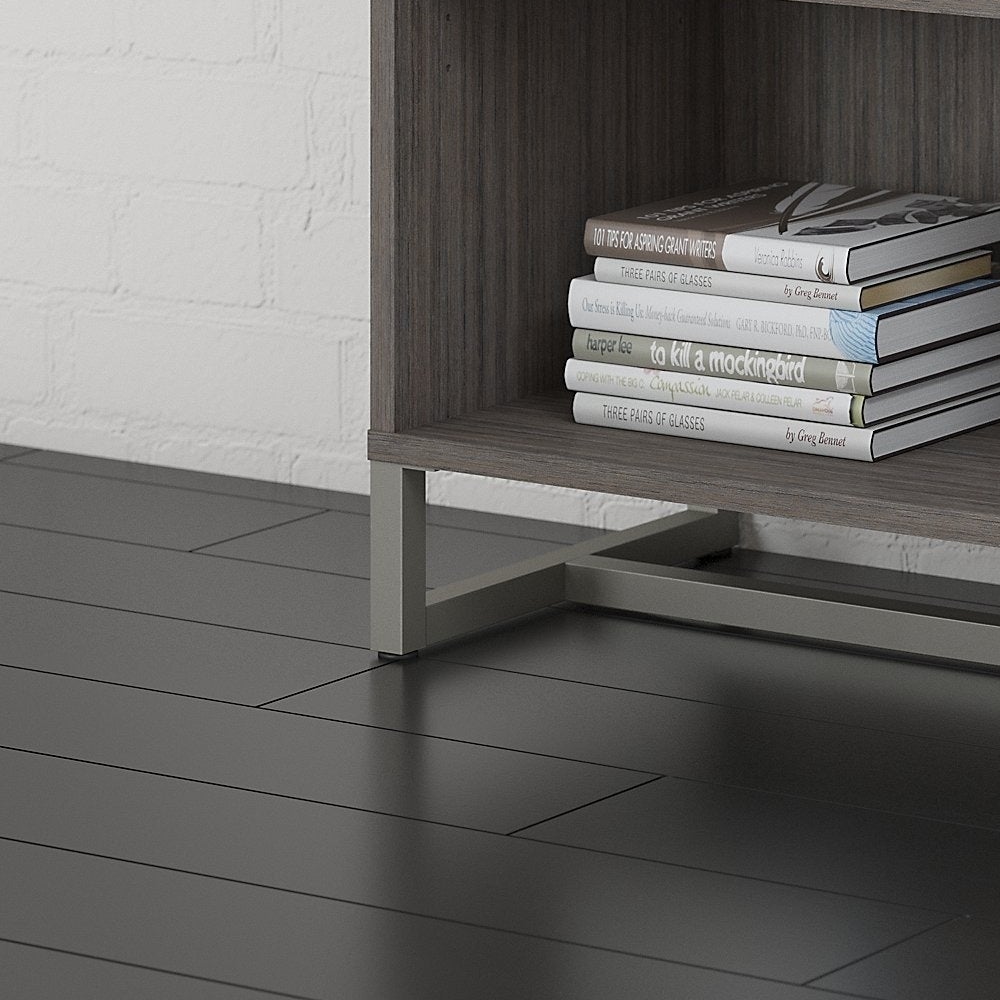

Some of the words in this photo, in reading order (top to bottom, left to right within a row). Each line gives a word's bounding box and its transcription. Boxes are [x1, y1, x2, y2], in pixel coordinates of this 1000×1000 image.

[594, 228, 605, 246] 101
[607, 229, 619, 249] TIPS
[620, 231, 634, 250] FOR
[634, 233, 663, 254] ASPIRING
[665, 236, 689, 256] GRANT
[690, 238, 718, 259] WRITERS
[754, 246, 778, 266] Veronica
[780, 249, 803, 269] Robbins
[621, 266, 643, 281] THREE
[645, 269, 666, 283] PAIRS
[668, 271, 678, 285] OF
[680, 273, 713, 288] GLASSES
[783, 284, 792, 298] by
[794, 285, 812, 301] Greg
[813, 288, 839, 301] Bennet
[587, 334, 617, 356] harper
[618, 336, 633, 355] lee
[650, 340, 666, 366] to
[670, 340, 692, 368] kill
[694, 349, 706, 371] a
[710, 349, 808, 384] mockingbird
[603, 404, 628, 421] THREE
[630, 407, 653, 425] PAIRS
[656, 410, 666, 426] OF
[669, 412, 705, 431] GLASSES
[785, 427, 795, 444] by
[797, 428, 817, 447] Greg
[819, 431, 847, 447] Bennet
